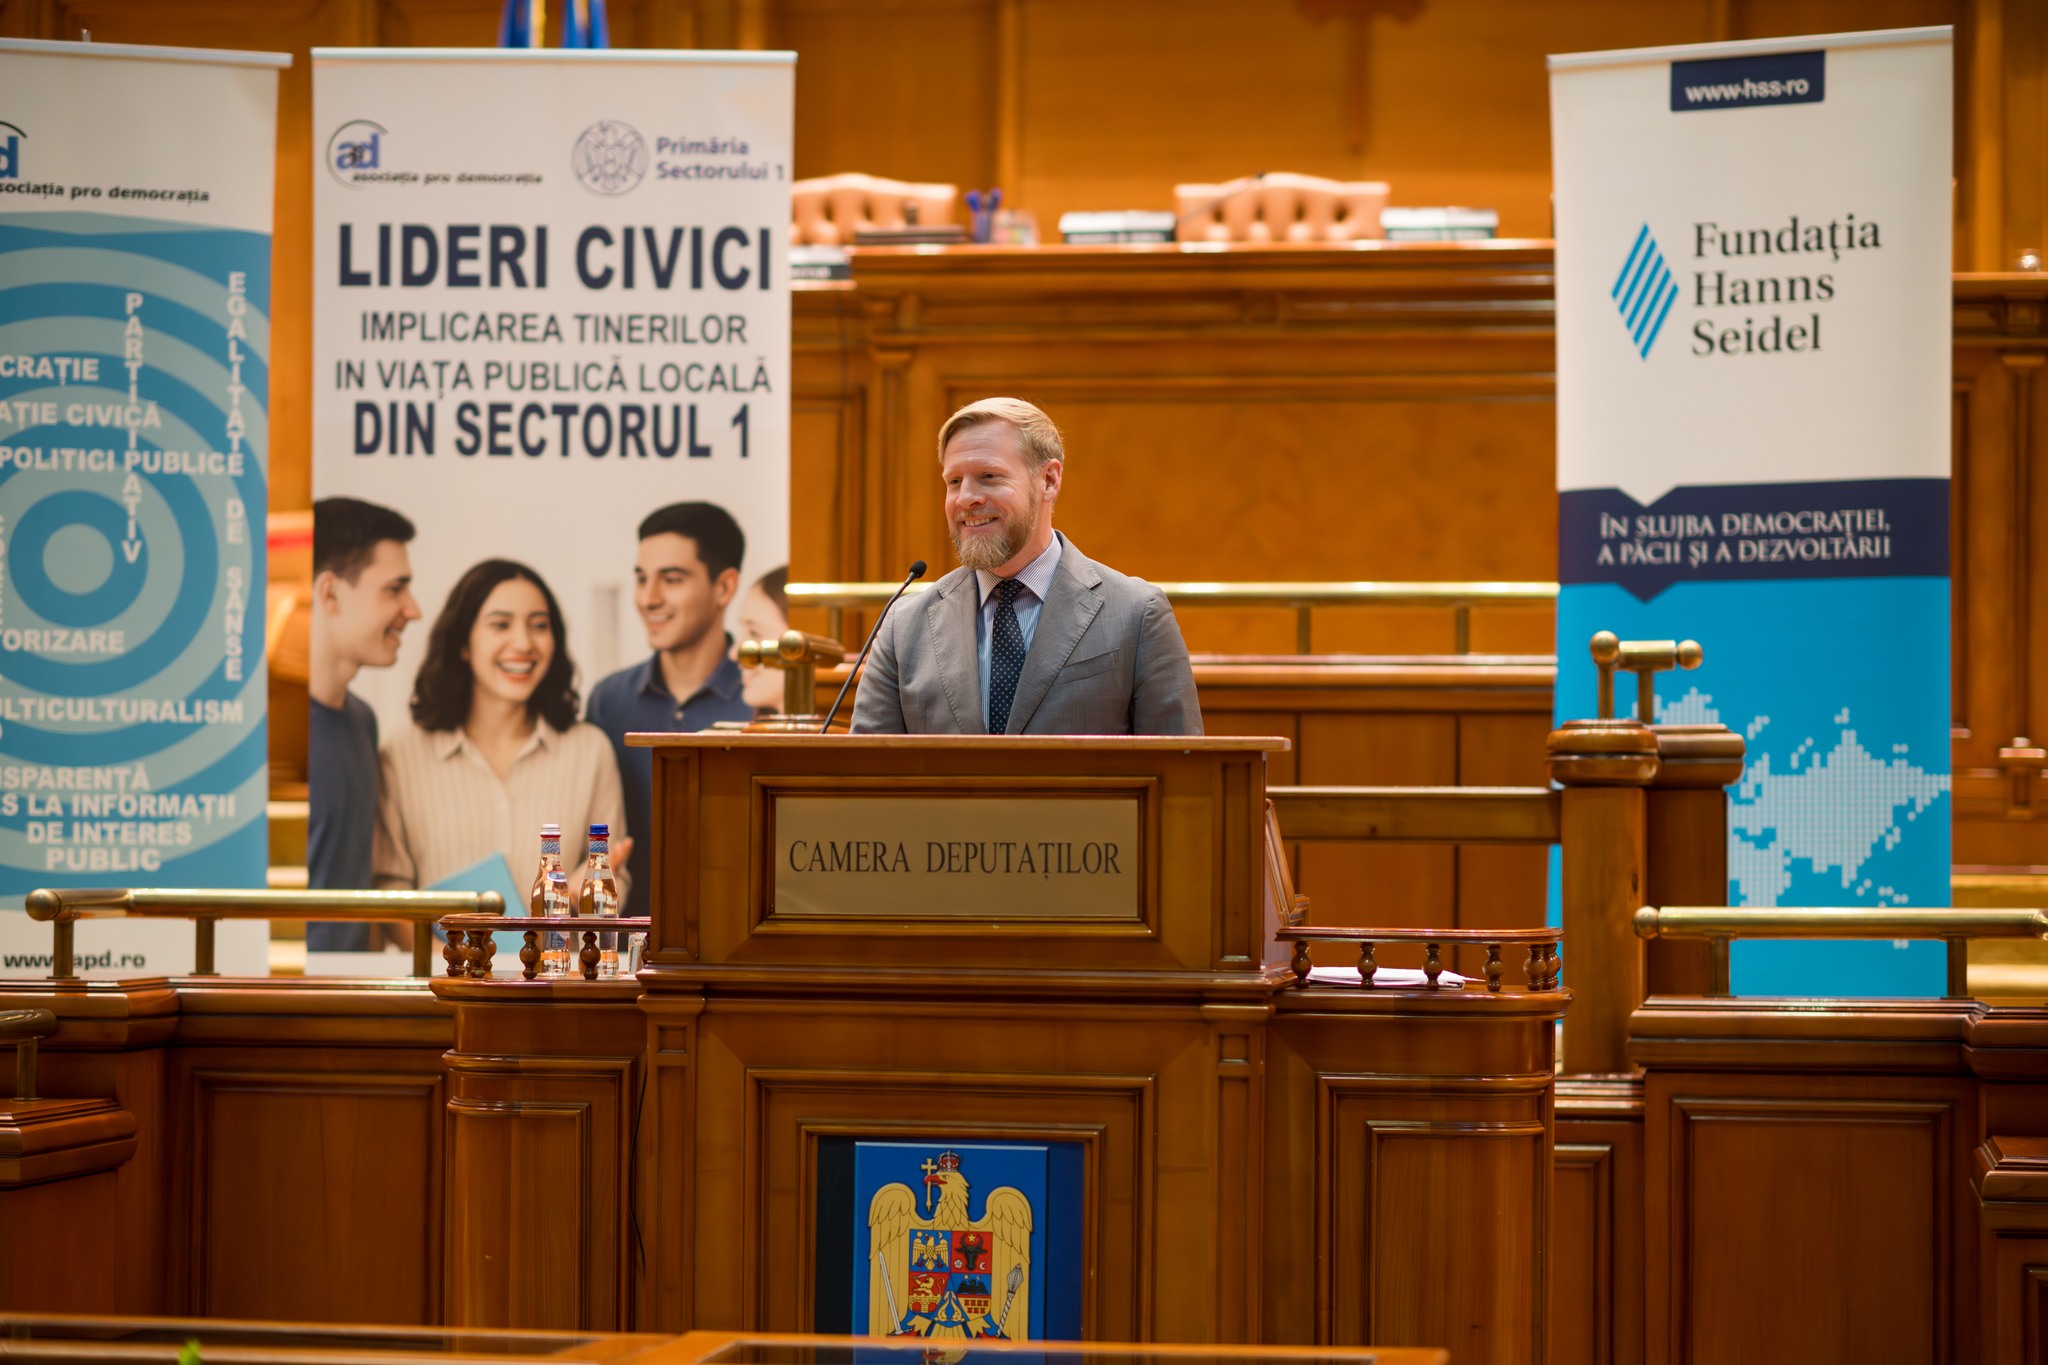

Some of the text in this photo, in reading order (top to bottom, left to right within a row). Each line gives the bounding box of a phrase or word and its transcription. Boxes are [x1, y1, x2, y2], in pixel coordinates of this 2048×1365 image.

[656, 136, 750, 155] Primăria
[656, 161, 785, 180] Sectorului 1
[71, 185, 102, 200] pro
[108, 186, 210, 207] democrația
[337, 223, 772, 291] LIDERI CIVICI
[1690, 270, 1836, 308] Hanns
[361, 311, 749, 345] IMPLICAREA TINERILOR
[1690, 312, 1823, 358] Seidel
[335, 360, 365, 391] IN
[484, 356, 627, 393] PUBLICĂ
[639, 356, 772, 394] LOCALĂ
[66, 401, 162, 430] CIVICĂ
[353, 400, 750, 459] DIN SECTORUL 1
[124, 450, 245, 476] PUBLICE
[1600, 510, 1629, 540] ÎN
[1634, 513, 1716, 541] SLUJBA
[1597, 543, 1615, 567] A
[1714, 540, 1733, 563] A
[27, 793, 64, 818] LA
[27, 820, 193, 846] DE INTERES
[46, 847, 162, 872] PUBLIC
[789, 840, 1122, 881] CAMERA DEPUTAȚILOR
[3, 949, 146, 971] wwwapd.ro
